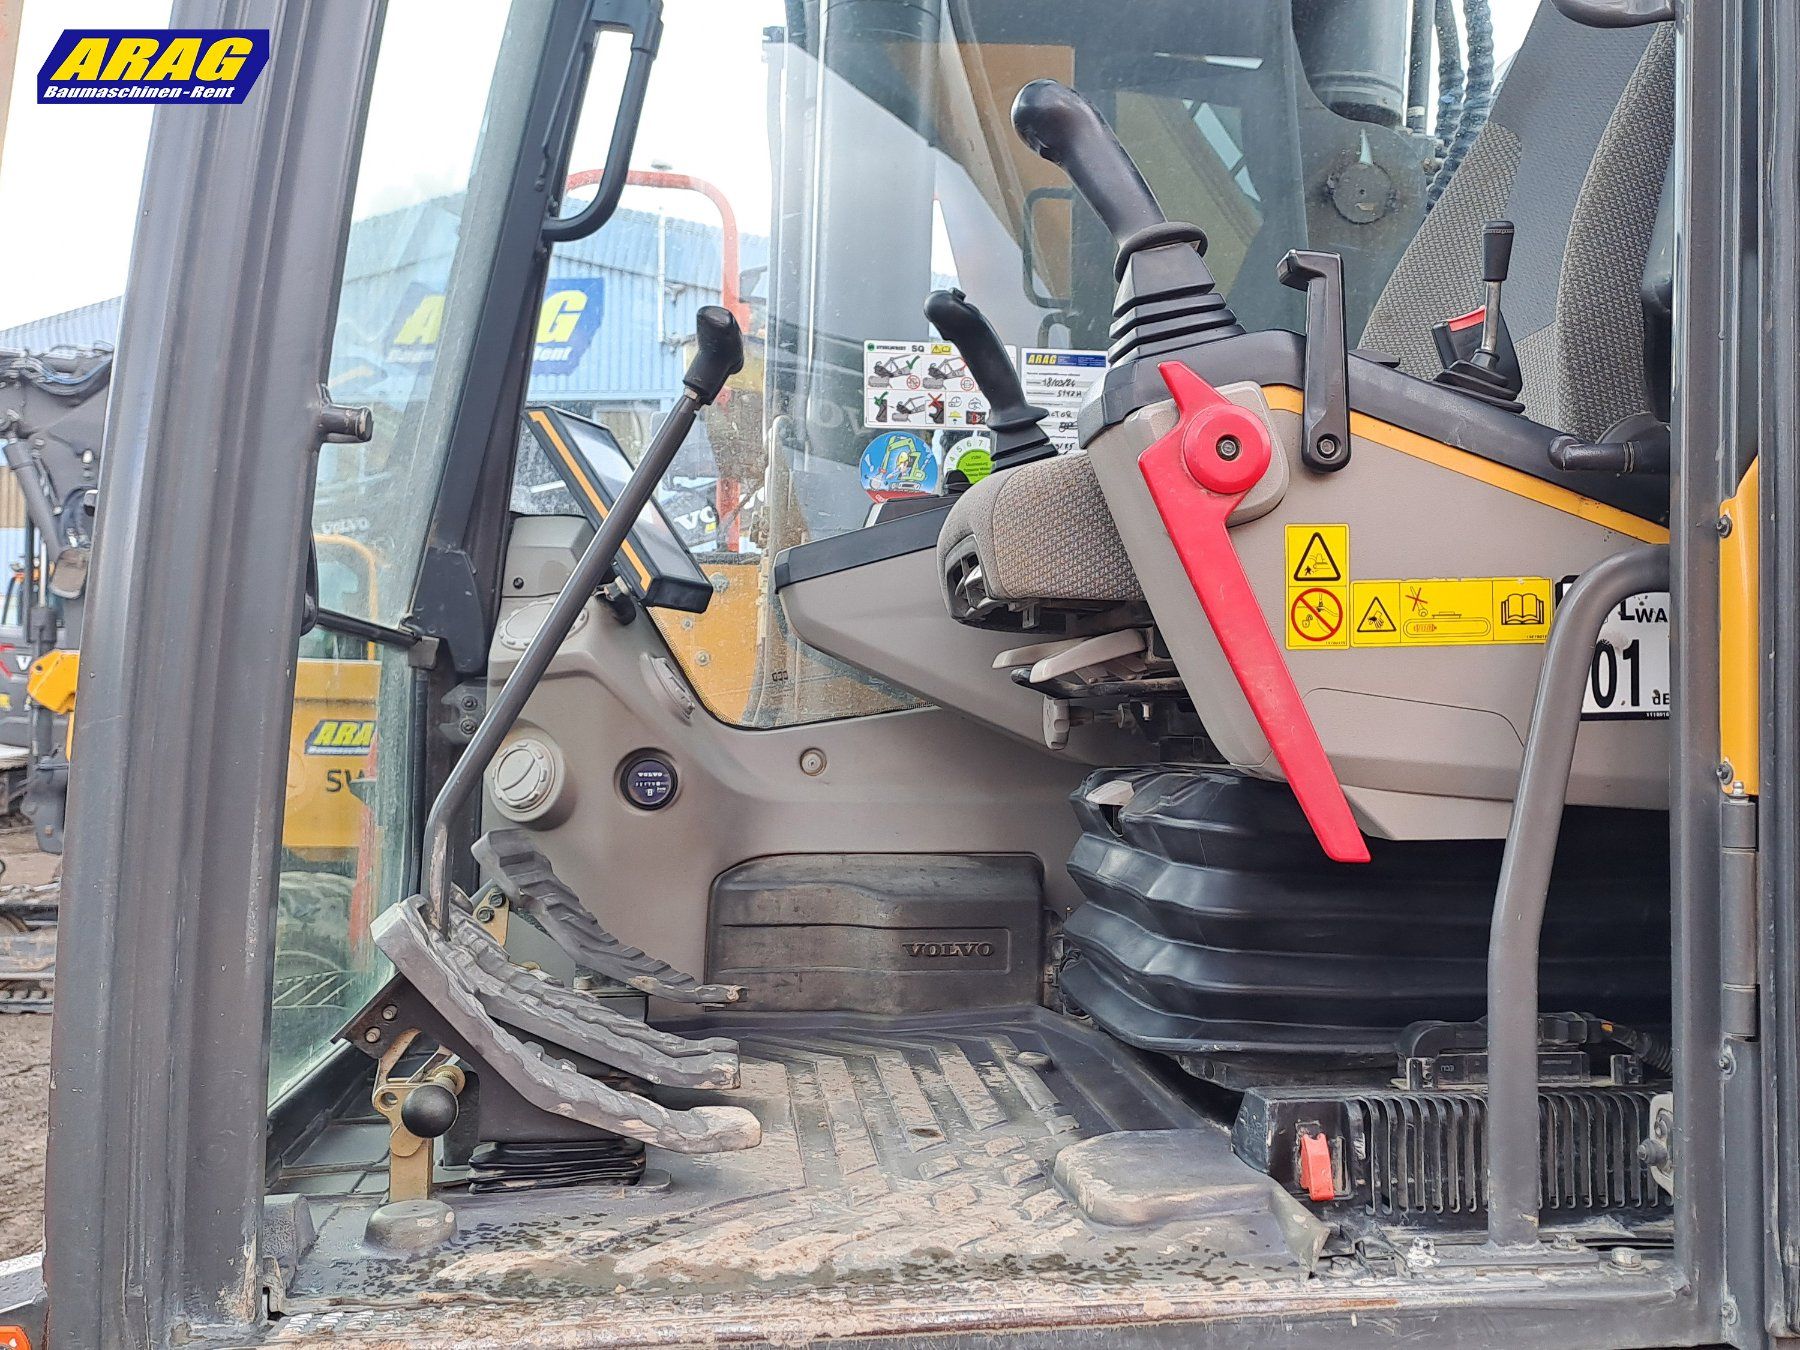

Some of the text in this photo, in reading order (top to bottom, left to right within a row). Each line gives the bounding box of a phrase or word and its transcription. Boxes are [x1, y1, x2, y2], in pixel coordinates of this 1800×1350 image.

[911, 344, 925, 352] SQ
[1027, 354, 1057, 364] ARAG
[312, 721, 375, 747] ARA
[902, 942, 995, 957] VOLVO
